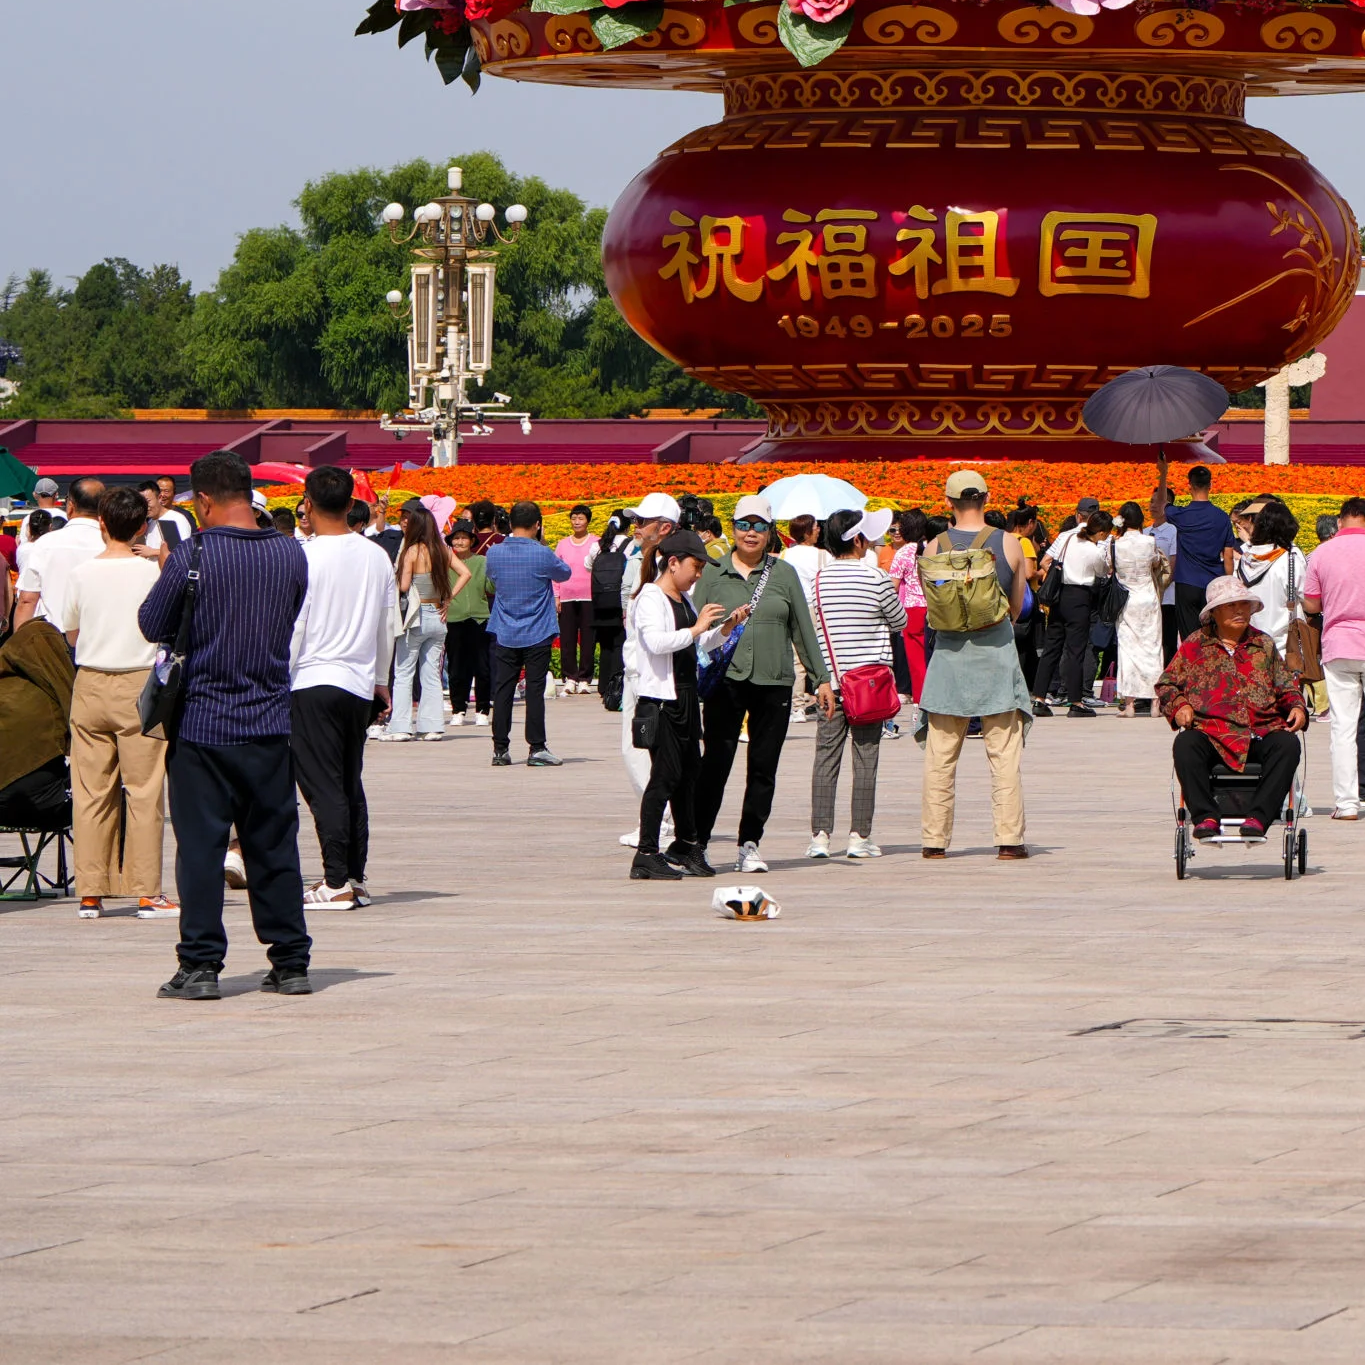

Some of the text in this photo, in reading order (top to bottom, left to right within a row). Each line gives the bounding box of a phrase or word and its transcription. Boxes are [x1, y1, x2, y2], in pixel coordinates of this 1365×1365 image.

[658, 205, 1157, 303] 祝福祖国
[777, 314, 1012, 339] 1949-2025
